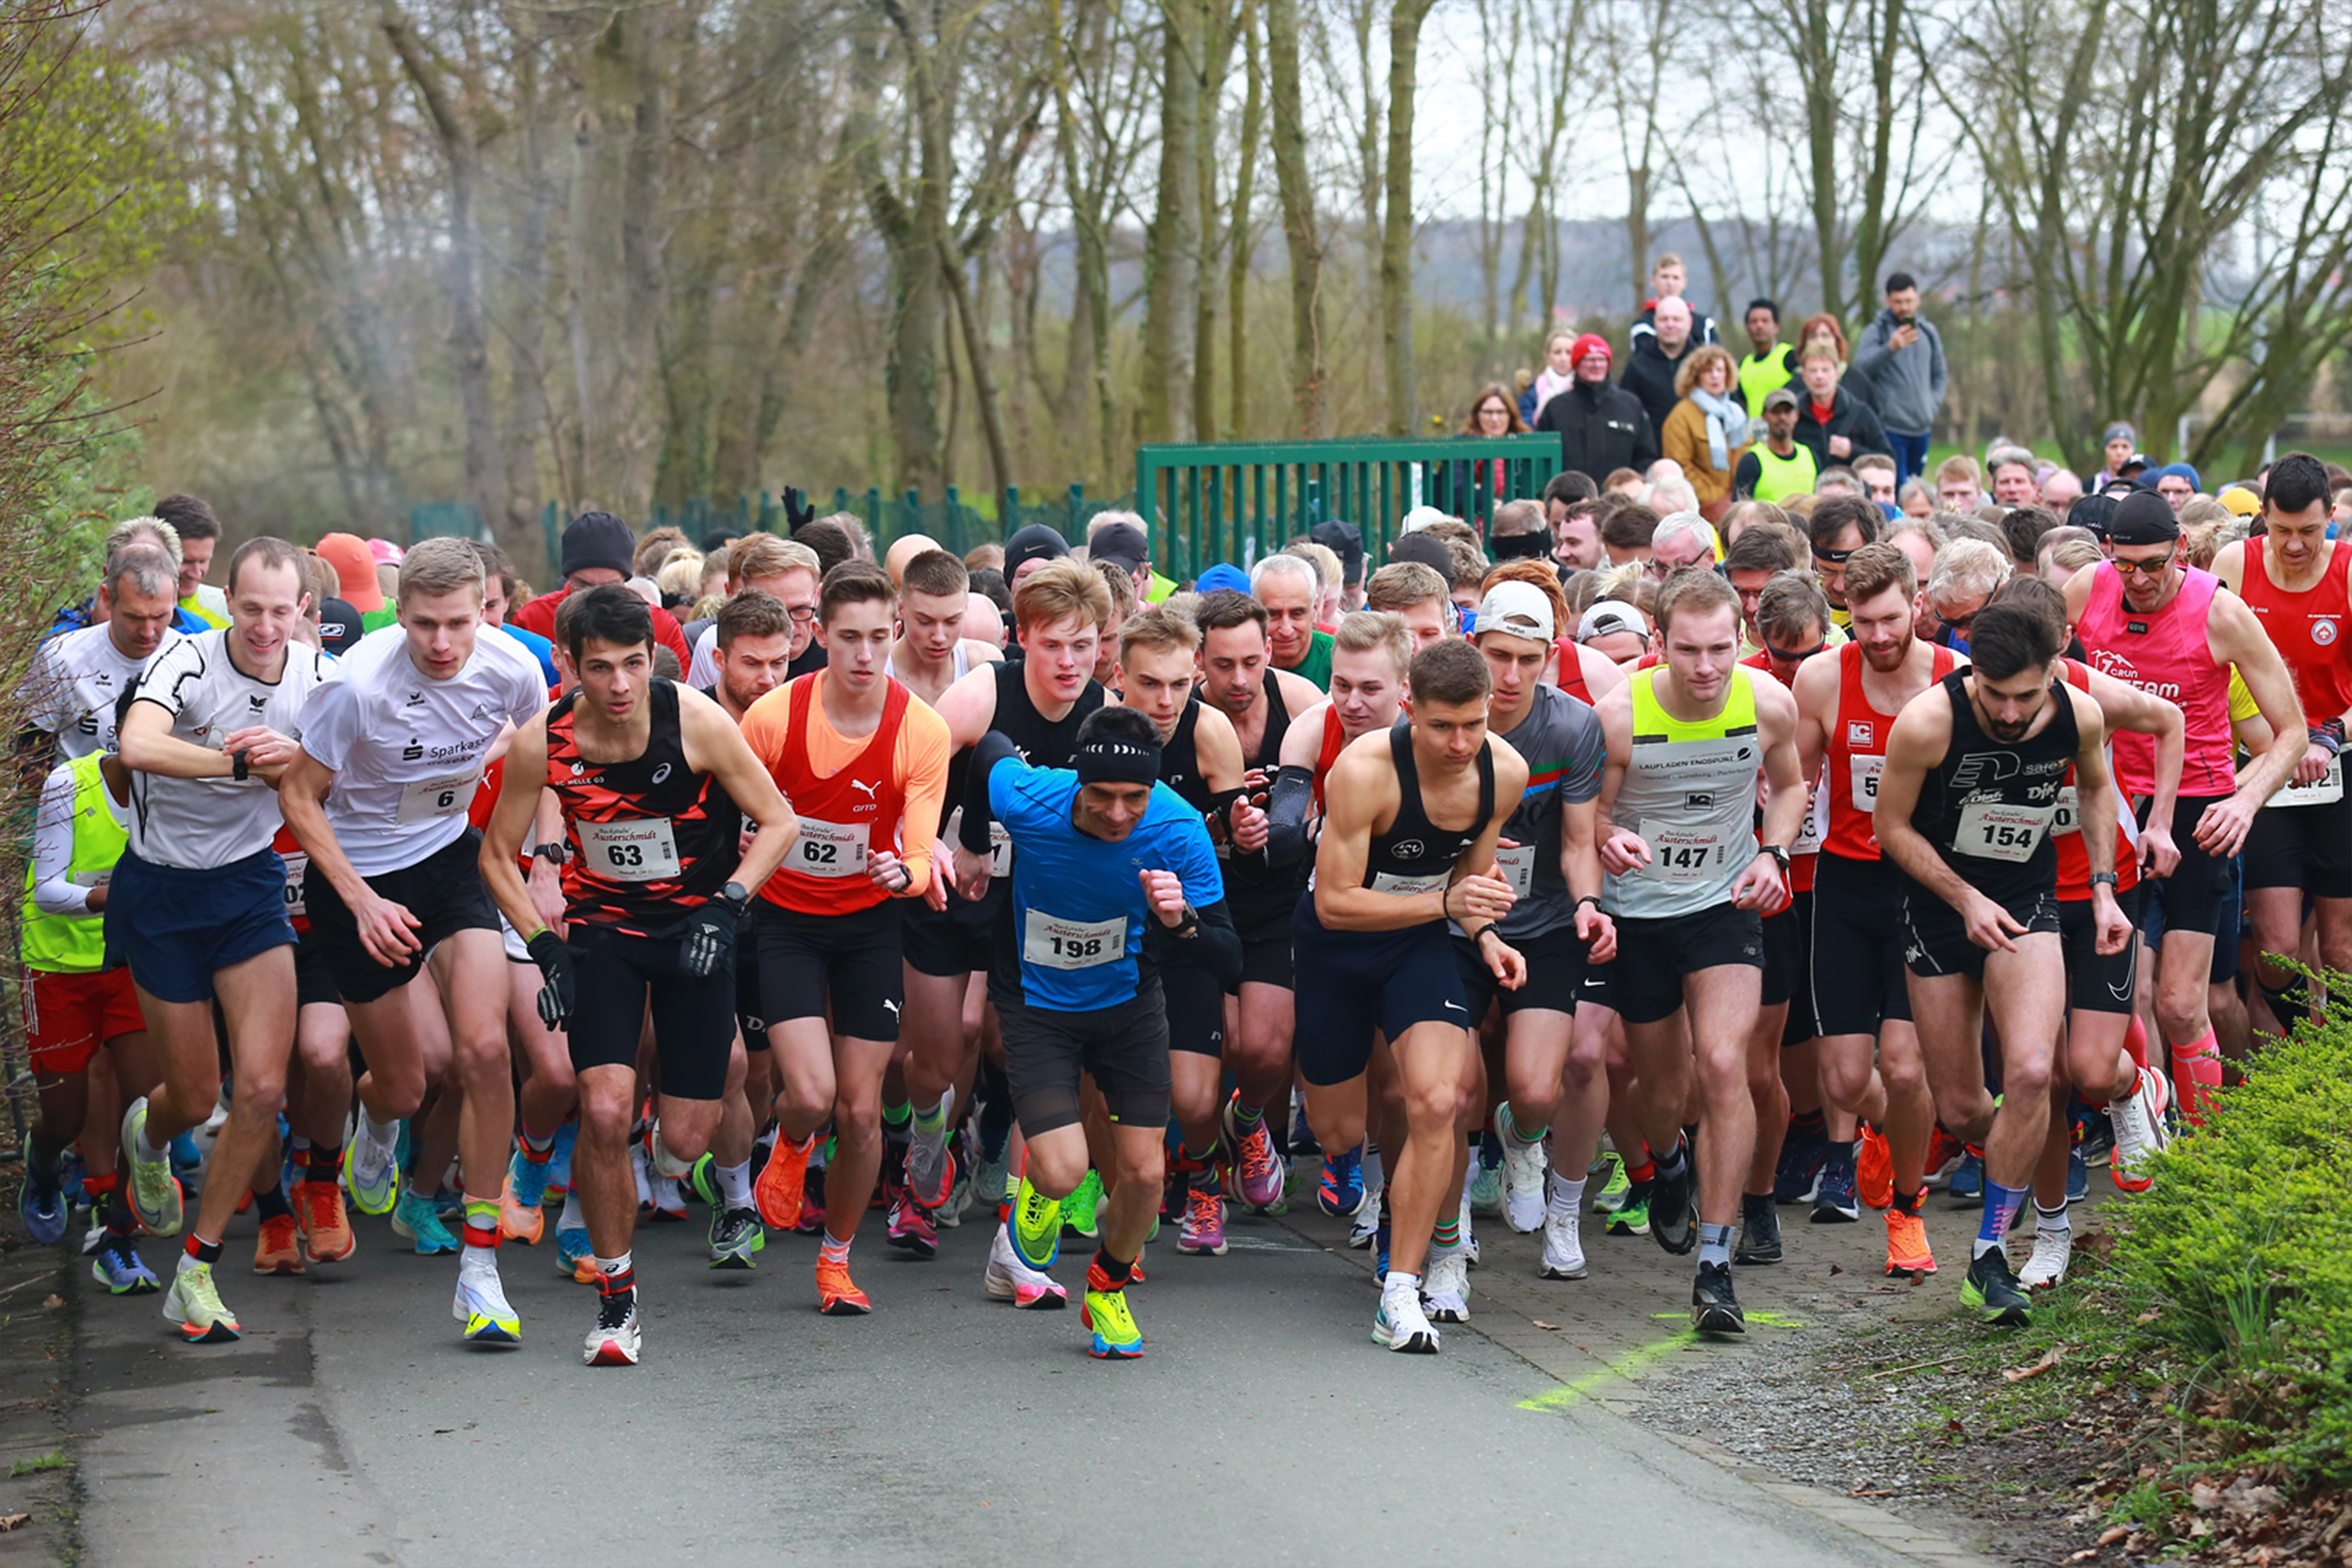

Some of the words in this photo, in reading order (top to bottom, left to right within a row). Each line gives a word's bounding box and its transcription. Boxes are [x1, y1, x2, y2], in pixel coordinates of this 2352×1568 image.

[429, 737, 487, 759] Sparkass
[1638, 760, 1689, 770] LAUFLADEN
[437, 790, 455, 808] 6
[800, 829, 855, 842] usterschmidt
[1982, 824, 2032, 848] 154
[608, 845, 644, 866] 63
[803, 840, 837, 863] 62
[1660, 846, 1708, 868] 147
[1050, 936, 1102, 958] 198
